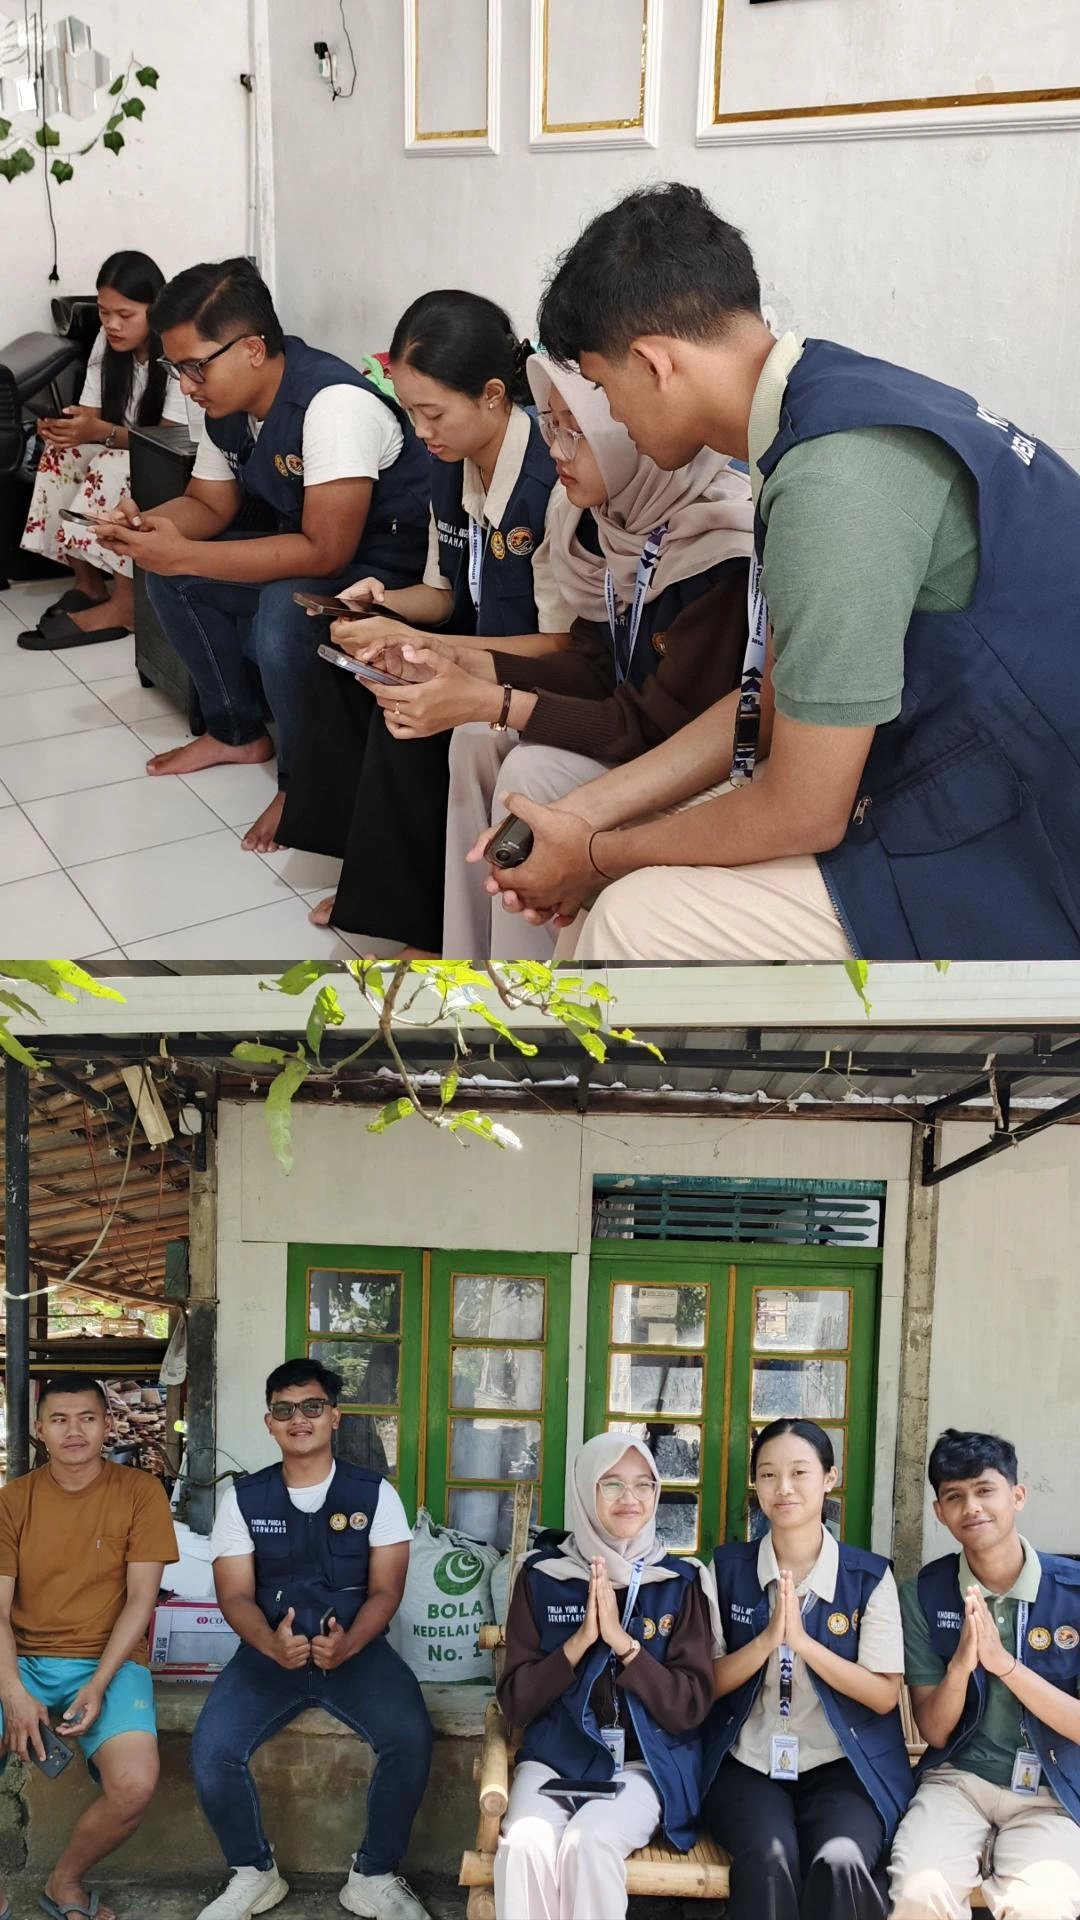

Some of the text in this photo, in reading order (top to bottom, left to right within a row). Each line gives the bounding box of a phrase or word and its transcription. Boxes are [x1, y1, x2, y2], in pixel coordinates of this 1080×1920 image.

[427, 1600, 484, 1619] BOLA
[413, 1624, 469, 1638] KEDELAI
[428, 1640, 482, 1662] No. 1
